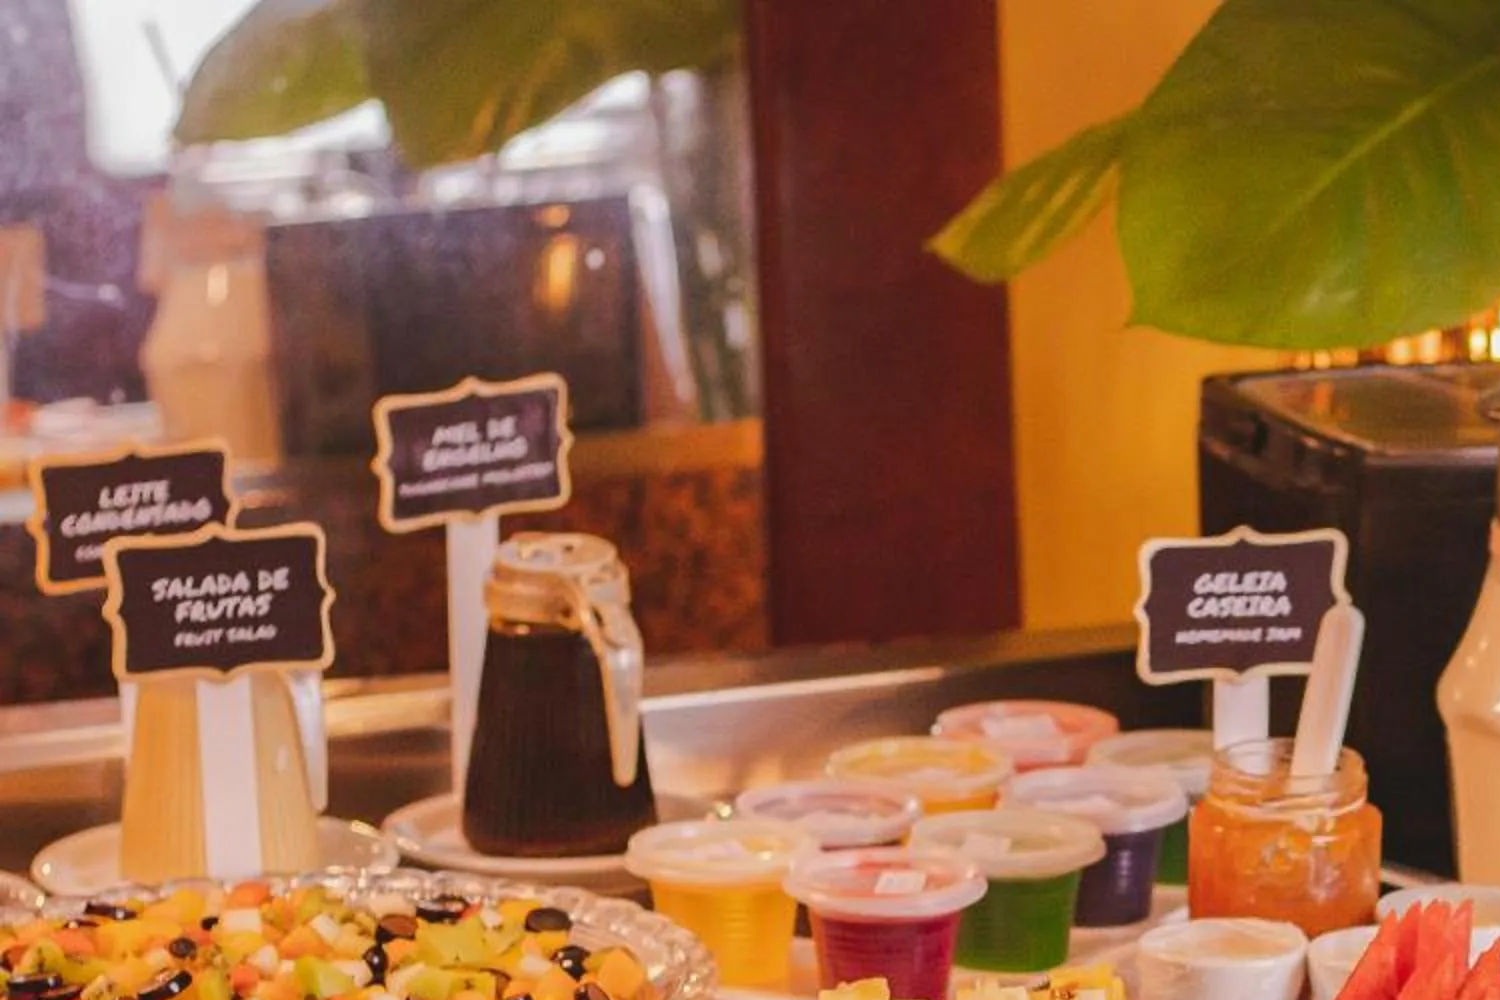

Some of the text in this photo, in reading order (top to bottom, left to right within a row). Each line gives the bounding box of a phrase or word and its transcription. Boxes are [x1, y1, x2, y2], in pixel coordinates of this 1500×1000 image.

[98, 479, 169, 508] LEITE
[151, 567, 289, 602] SALADA DE
[1193, 571, 1287, 594] GELEIA
[174, 593, 273, 623] FRUTAS
[1187, 595, 1291, 618] CASEIRA
[174, 624, 278, 647] FRUIT SALAD
